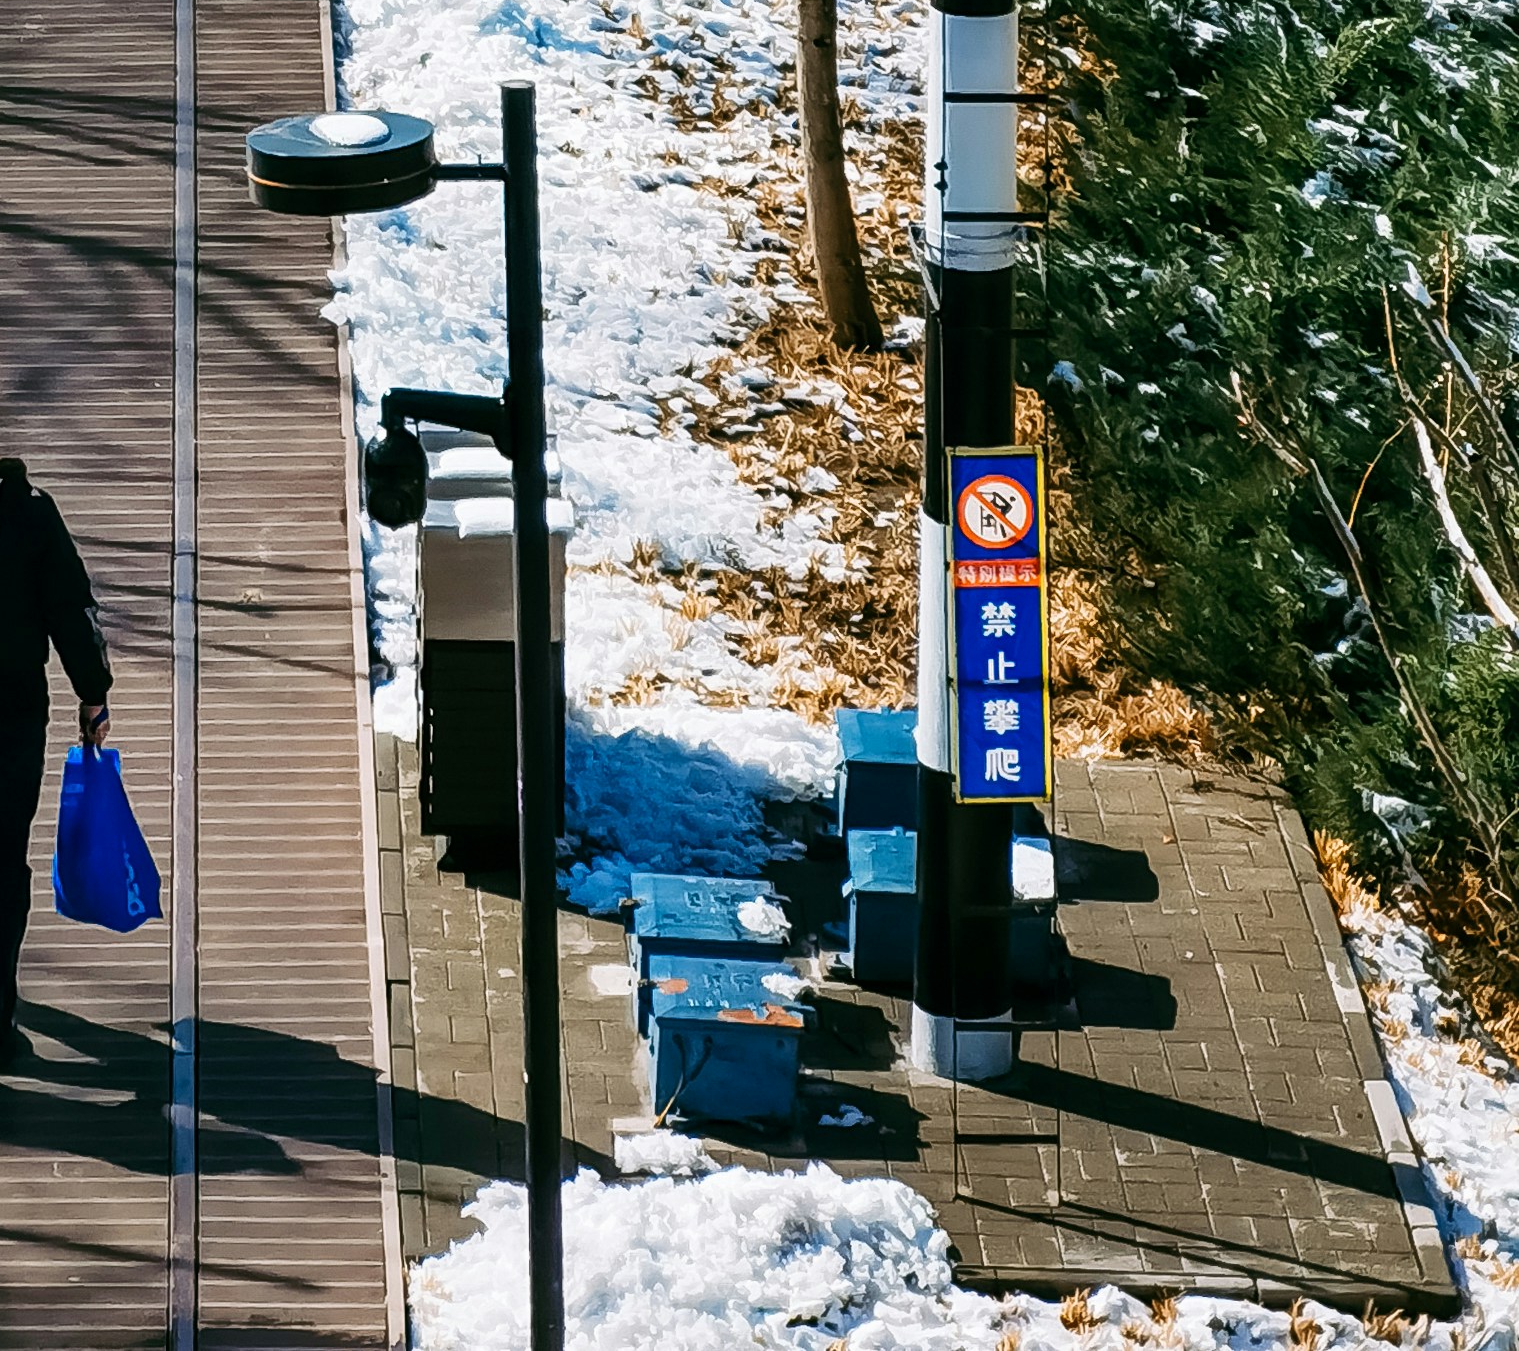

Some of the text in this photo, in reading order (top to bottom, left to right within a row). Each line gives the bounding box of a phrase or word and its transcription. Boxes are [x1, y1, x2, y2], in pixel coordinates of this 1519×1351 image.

[958, 565, 1037, 584] 特别提示
[981, 602, 1022, 782] 禁止攀爬
